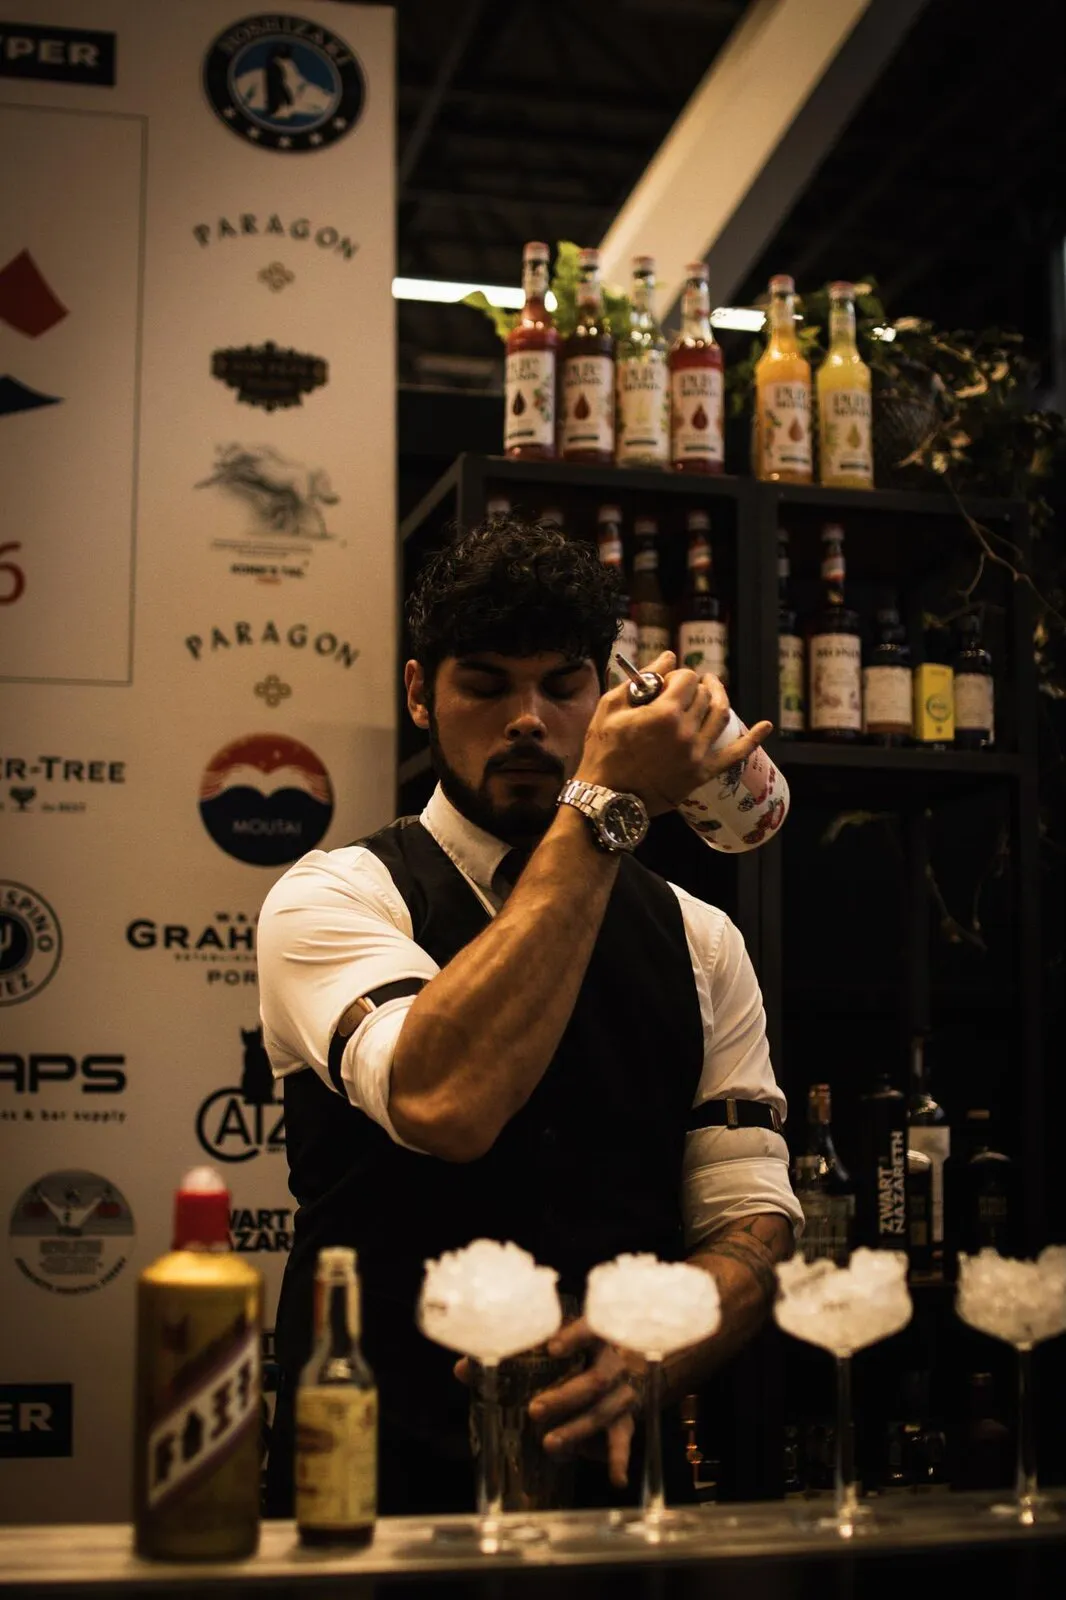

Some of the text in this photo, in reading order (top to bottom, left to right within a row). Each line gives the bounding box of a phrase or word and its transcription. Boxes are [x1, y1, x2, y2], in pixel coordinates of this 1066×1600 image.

[0, 34, 101, 69] PER
[191, 213, 360, 261] PARAGON
[185, 621, 359, 669] PARAGON
[0, 756, 127, 784] R-TREE
[0, 890, 54, 953] SPINO
[890, 1130, 906, 1235] NAZARETH
